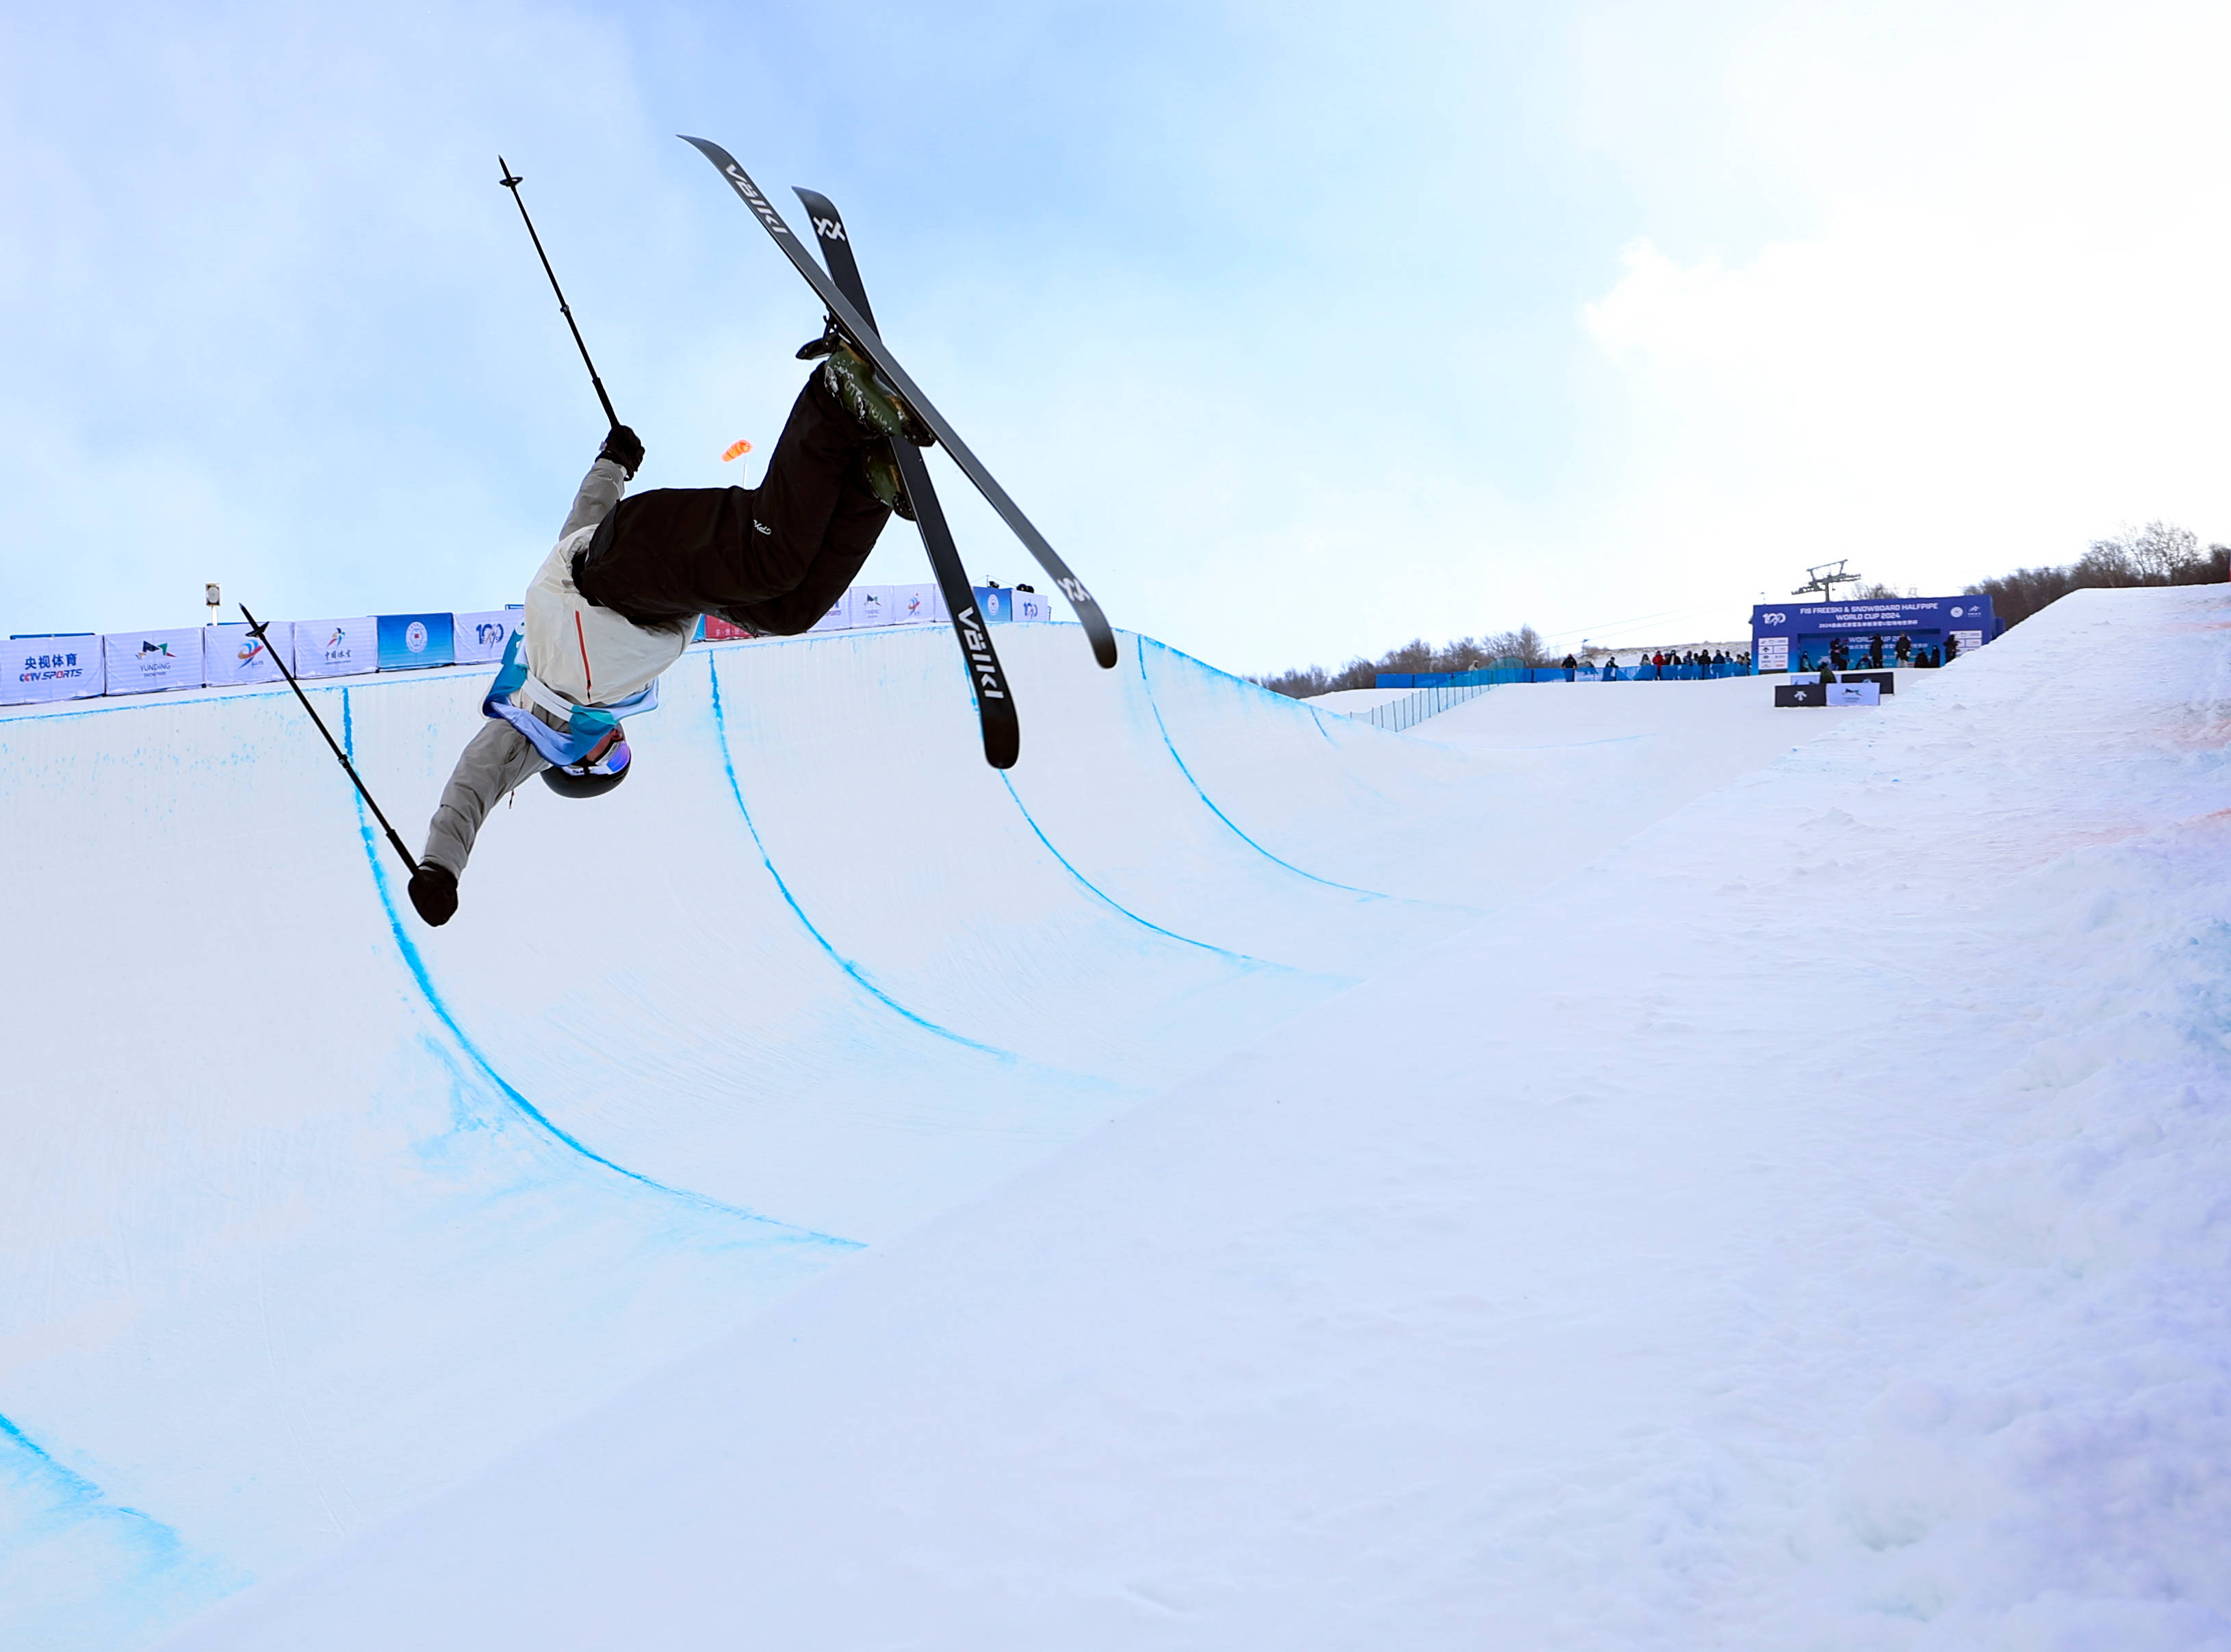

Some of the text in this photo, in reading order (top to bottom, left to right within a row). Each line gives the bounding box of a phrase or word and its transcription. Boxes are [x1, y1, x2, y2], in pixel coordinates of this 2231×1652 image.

[1851, 604, 1900, 612] SNOWBOARD
[25, 652, 77, 670] 央视体育
[140, 662, 170, 671] YUNDING
[42, 669, 83, 680] SPORTS
